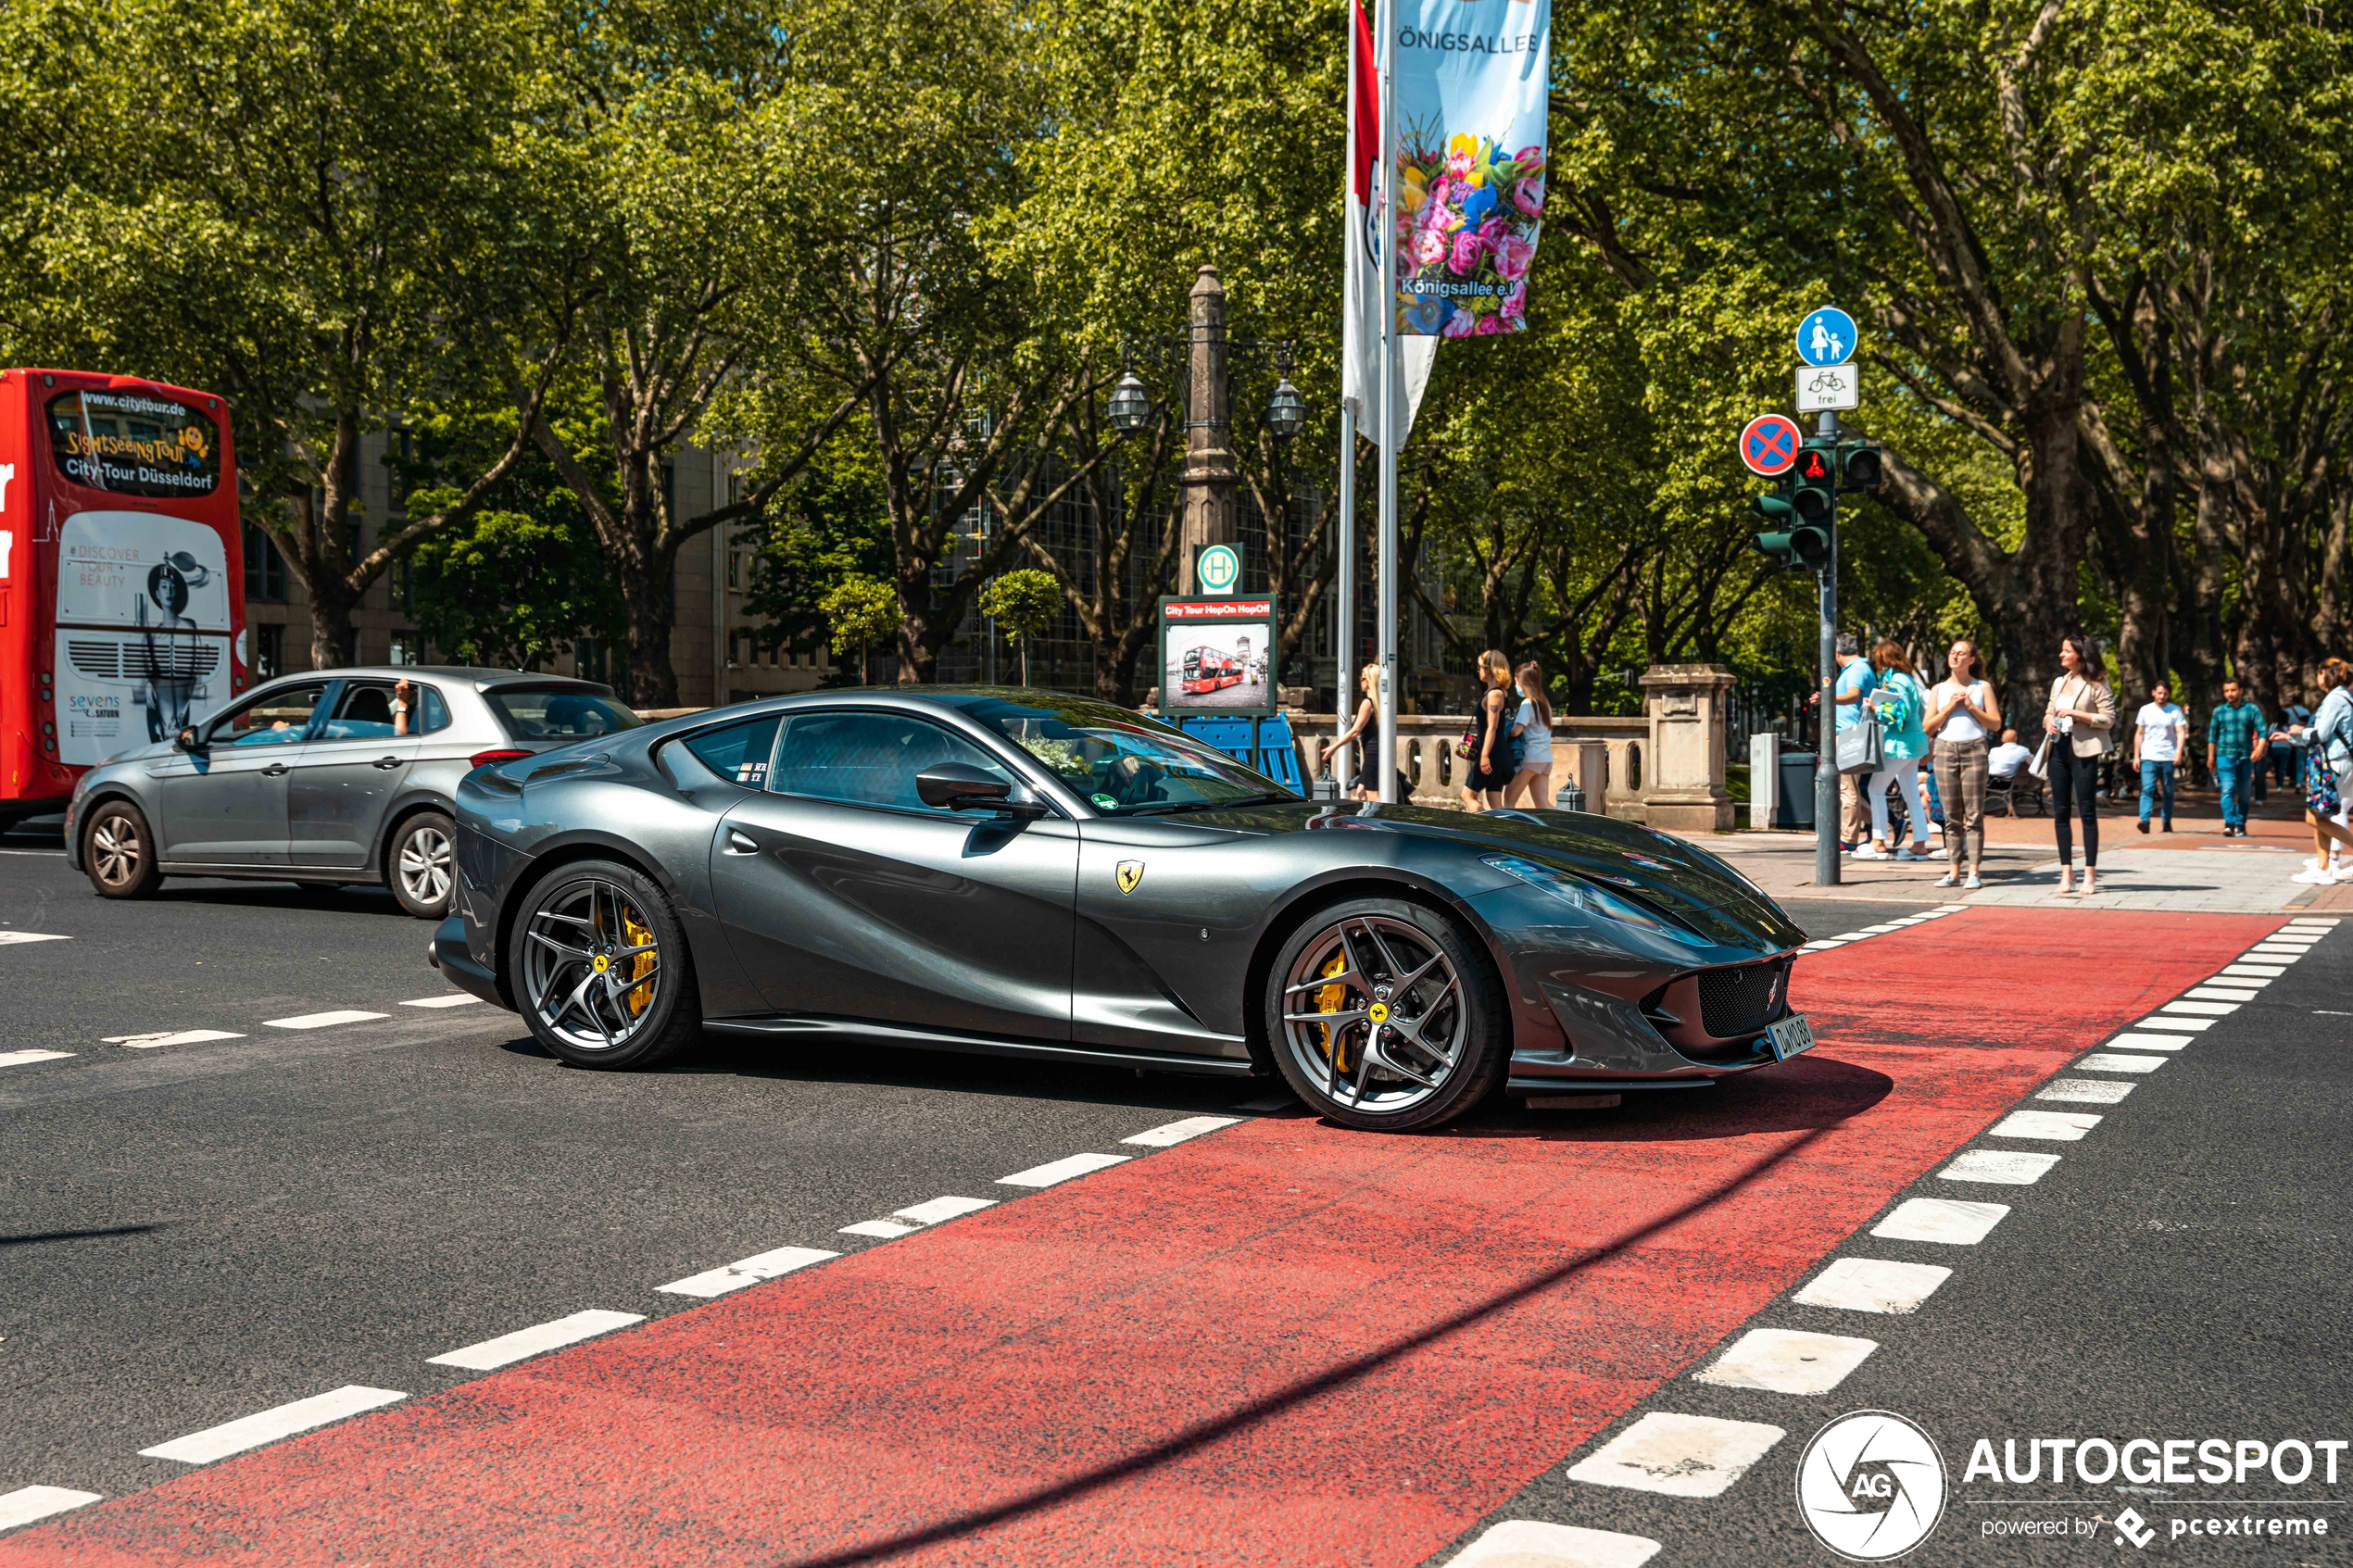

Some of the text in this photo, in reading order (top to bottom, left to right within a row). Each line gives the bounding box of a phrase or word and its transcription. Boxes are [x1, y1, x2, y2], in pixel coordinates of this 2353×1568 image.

[1396, 25, 1537, 54] ÖNIGSALLEE
[1402, 279, 1492, 297] Königsallee
[82, 391, 185, 416] www.citytour.de
[1818, 395, 1836, 404] frei
[66, 458, 212, 490] City-Tour Düsseldorf
[80, 561, 113, 572] YOUR
[1211, 557, 1226, 580] H
[80, 574, 125, 587] BEAUTY
[1165, 604, 1270, 617] City Tour HopOn HopOff
[69, 696, 120, 708] sevens
[95, 709, 120, 718] SATURN
[1776, 1028, 1788, 1054] D
